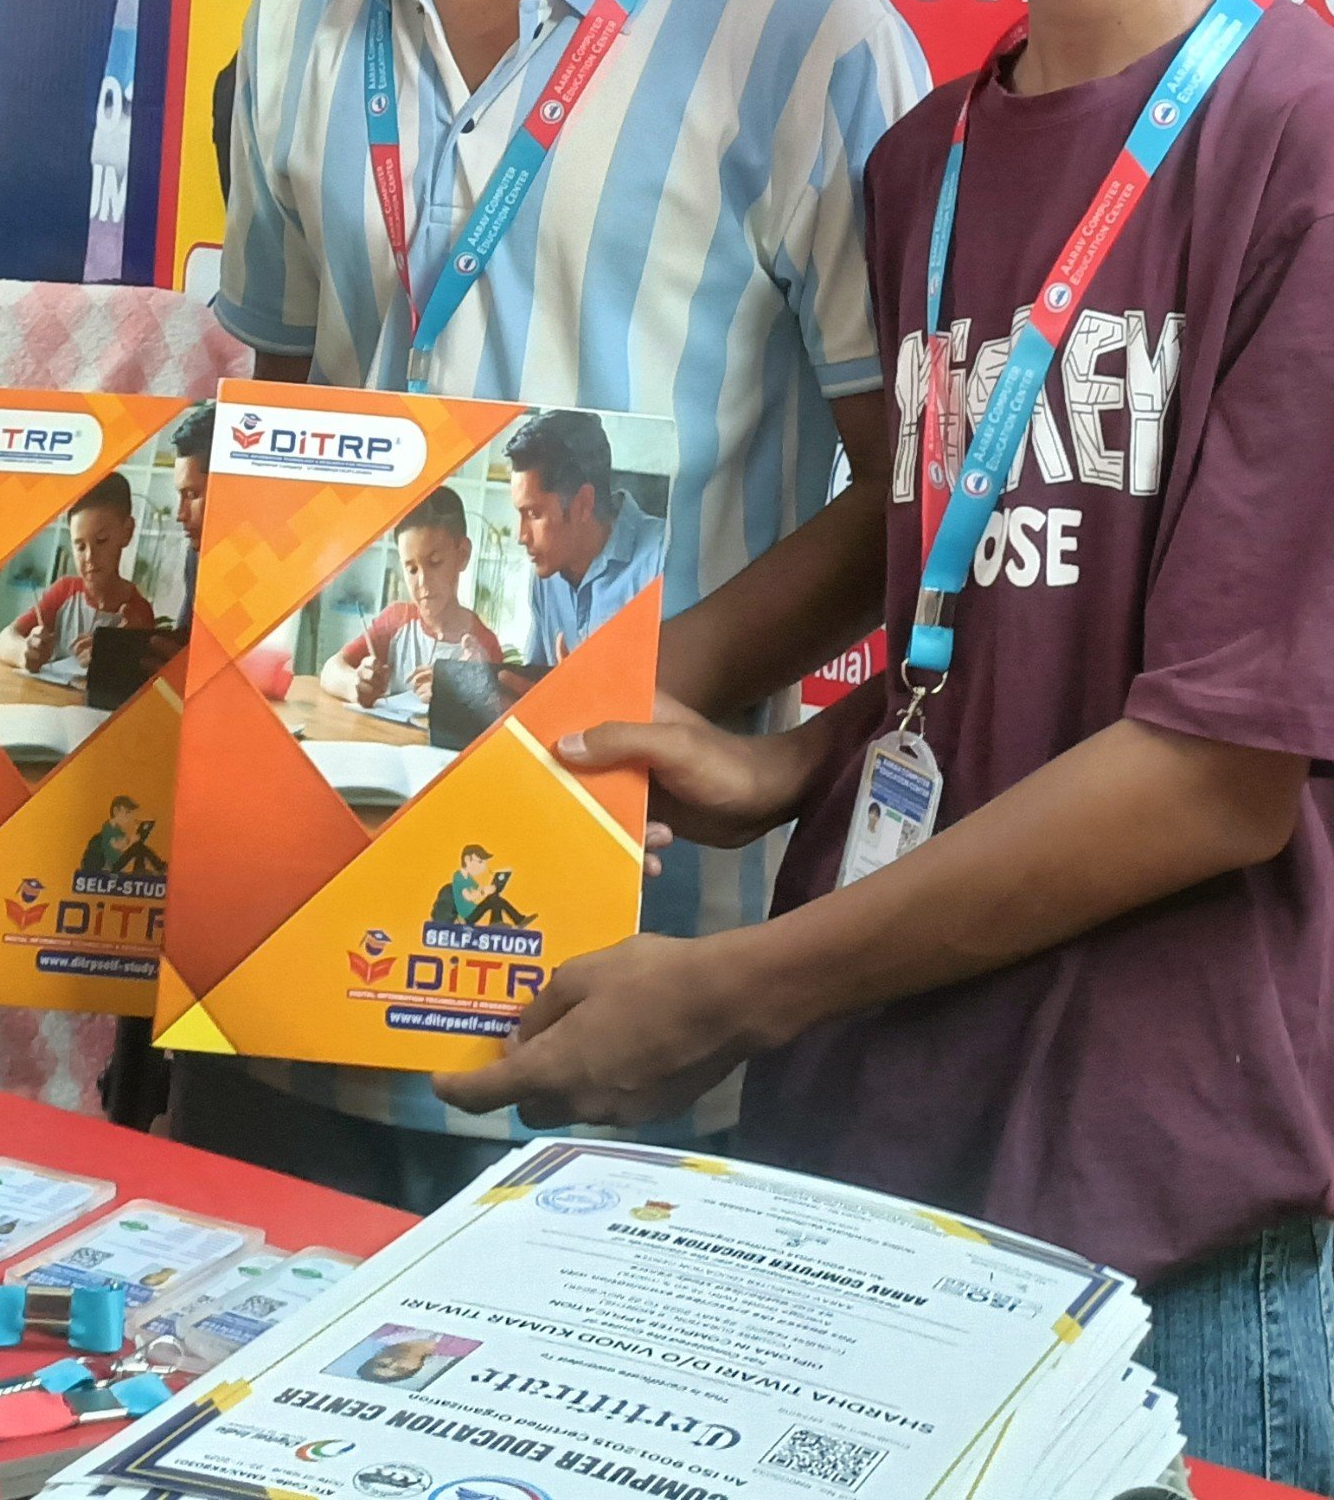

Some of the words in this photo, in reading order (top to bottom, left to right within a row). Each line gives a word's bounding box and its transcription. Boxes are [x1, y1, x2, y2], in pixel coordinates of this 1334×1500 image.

[554, 62, 576, 95] AARAV
[571, 16, 604, 62] COMPUTER
[561, 53, 596, 103] EDUCATION
[593, 19, 617, 54] CENTER
[467, 213, 491, 247] AARAV
[484, 166, 517, 214] COMPUTER
[476, 204, 509, 255] EDUCATION
[504, 169, 530, 204] CENTER
[1060, 234, 1087, 276] AARAV
[1080, 179, 1122, 237] COMPUTER
[1069, 223, 1111, 287] EDUCATION
[1104, 182, 1136, 224] CENTER
[972, 422, 997, 463] AARAV
[986, 365, 1023, 423] COMPUTER
[985, 407, 1018, 473] EDUCATION
[1012, 368, 1036, 413] CENTER
[75, 876, 166, 897] SELF-STUD
[426, 928, 541, 955] SELF-STUDY
[606, 1223, 671, 1241] CENTER
[672, 1236, 766, 1265] EDUCATION
[767, 1258, 865, 1290] COMPUTER
[400, 1297, 481, 1320] TIWARI
[866, 1284, 929, 1307] AARAV
[487, 1312, 575, 1341] KUMAR
[577, 1331, 654, 1358] VINOD
[661, 1349, 710, 1372] D/O
[713, 1363, 803, 1398] TIWARI
[272, 1386, 387, 1422] CENTER
[408, 1392, 512, 1425] Organization
[470, 1366, 742, 1451] Certificate
[811, 1390, 936, 1435] SHARDHA
[389, 1411, 555, 1462] EDUCATION
[513, 1417, 590, 1443] Certified
[593, 1437, 685, 1467] 9001:2015
[689, 1463, 720, 1478] ISO
